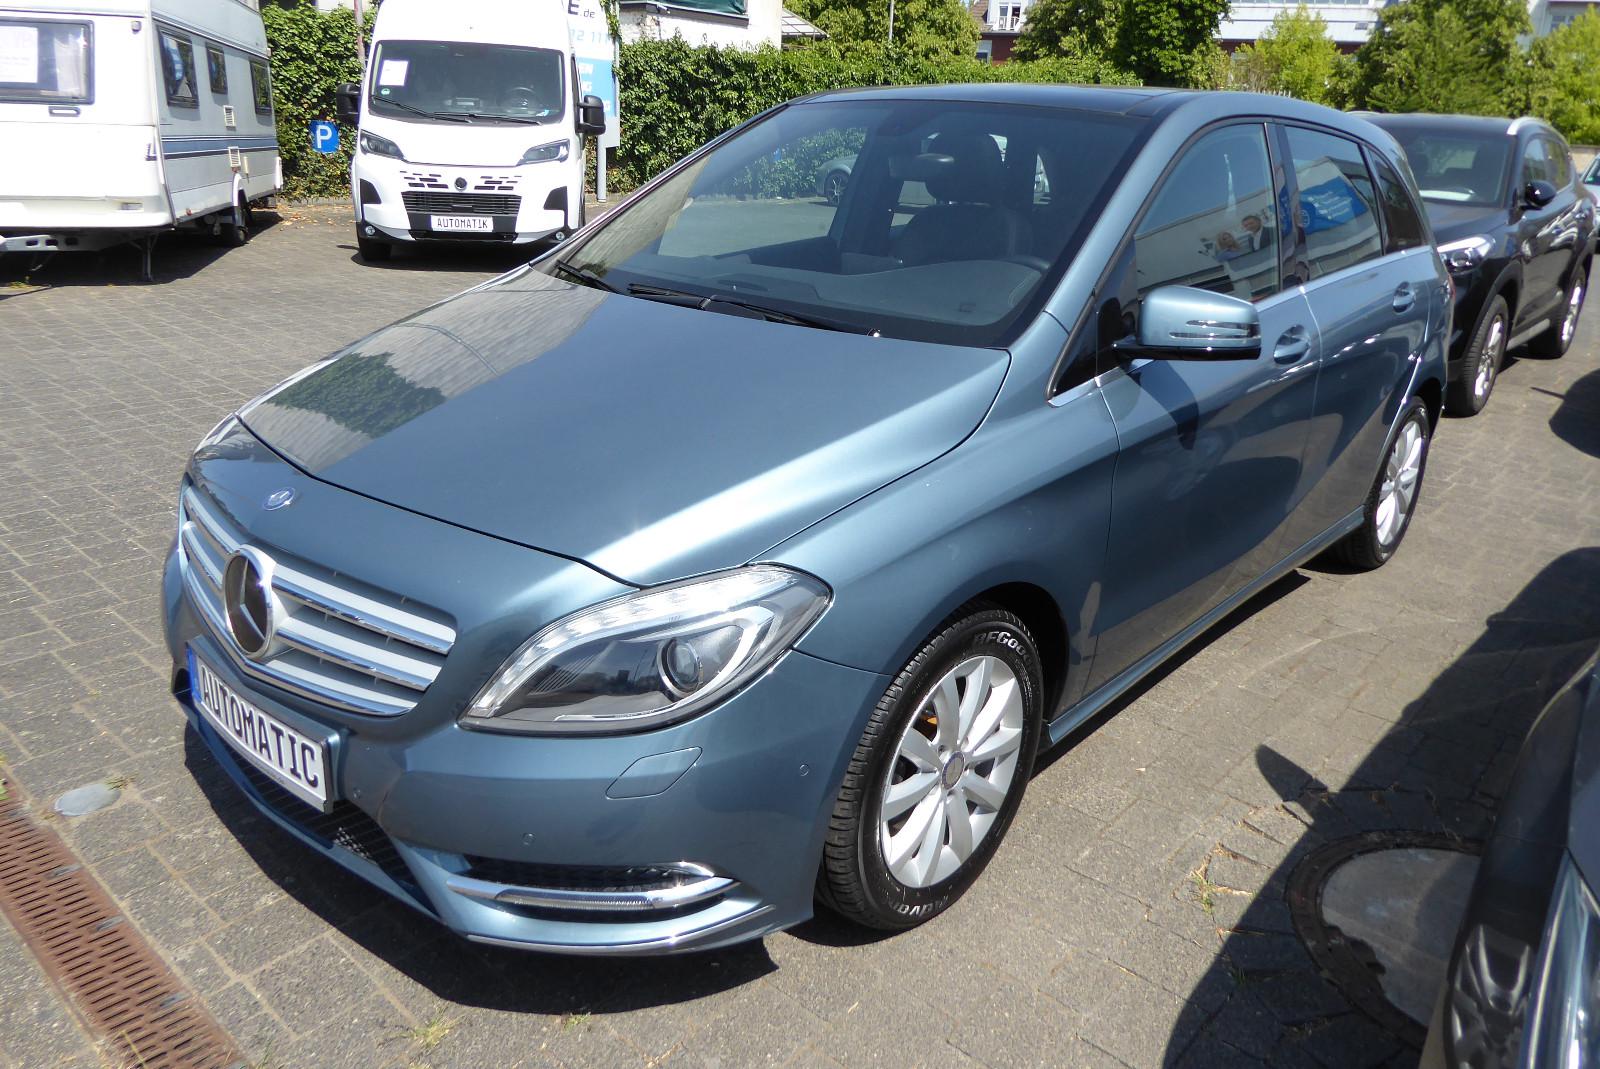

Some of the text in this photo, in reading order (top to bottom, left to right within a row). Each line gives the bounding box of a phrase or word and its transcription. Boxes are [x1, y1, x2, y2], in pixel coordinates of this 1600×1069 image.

[316, 124, 332, 148] P
[437, 218, 488, 229] AUTOMATIK
[201, 664, 318, 788] AUTOMATIC
